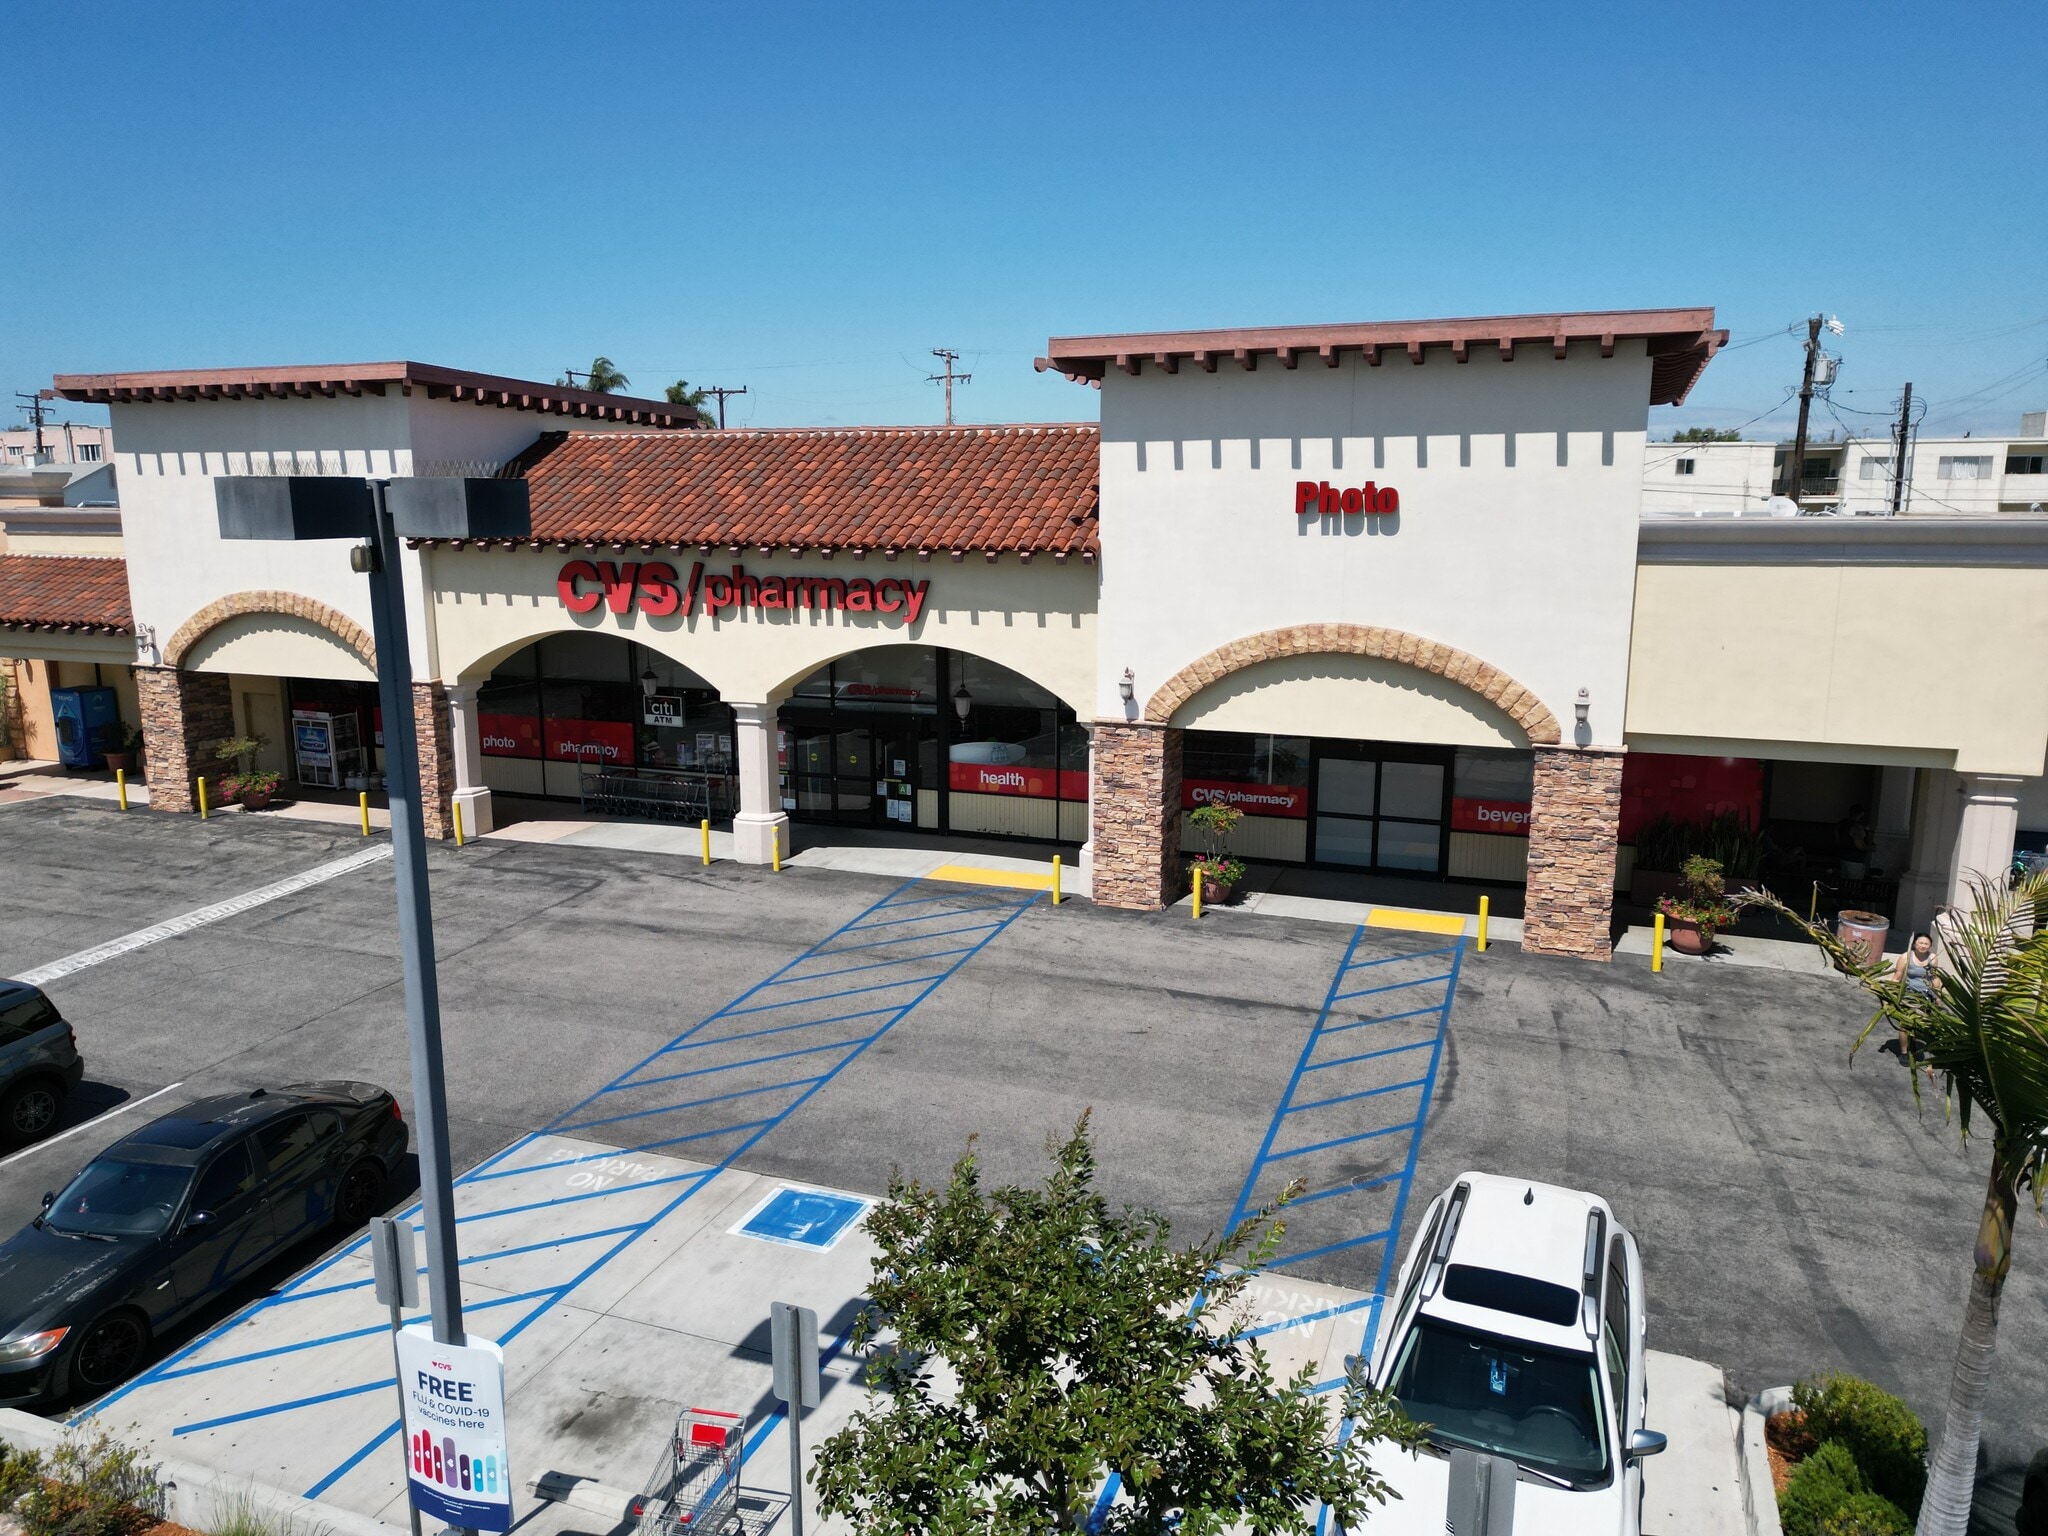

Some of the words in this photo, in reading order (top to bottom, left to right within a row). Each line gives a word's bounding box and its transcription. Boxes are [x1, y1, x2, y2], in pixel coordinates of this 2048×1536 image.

[1295, 481, 1399, 514] Photo
[556, 559, 931, 624] CVS/pharmacy
[651, 701, 673, 716] citi
[653, 715, 673, 724] ATM
[483, 735, 515, 749] photo
[560, 740, 619, 758] pharmacy
[980, 770, 1025, 786] health
[1192, 787, 1295, 808] CVS/pharmacy
[566, 1172, 614, 1191] NO
[437, 1362, 453, 1371] CVS
[412, 1390, 428, 1405] FLU
[428, 1398, 436, 1409] &
[437, 1402, 490, 1418] COVID-19
[417, 1405, 457, 1427] vaccines
[458, 1417, 485, 1429] here
